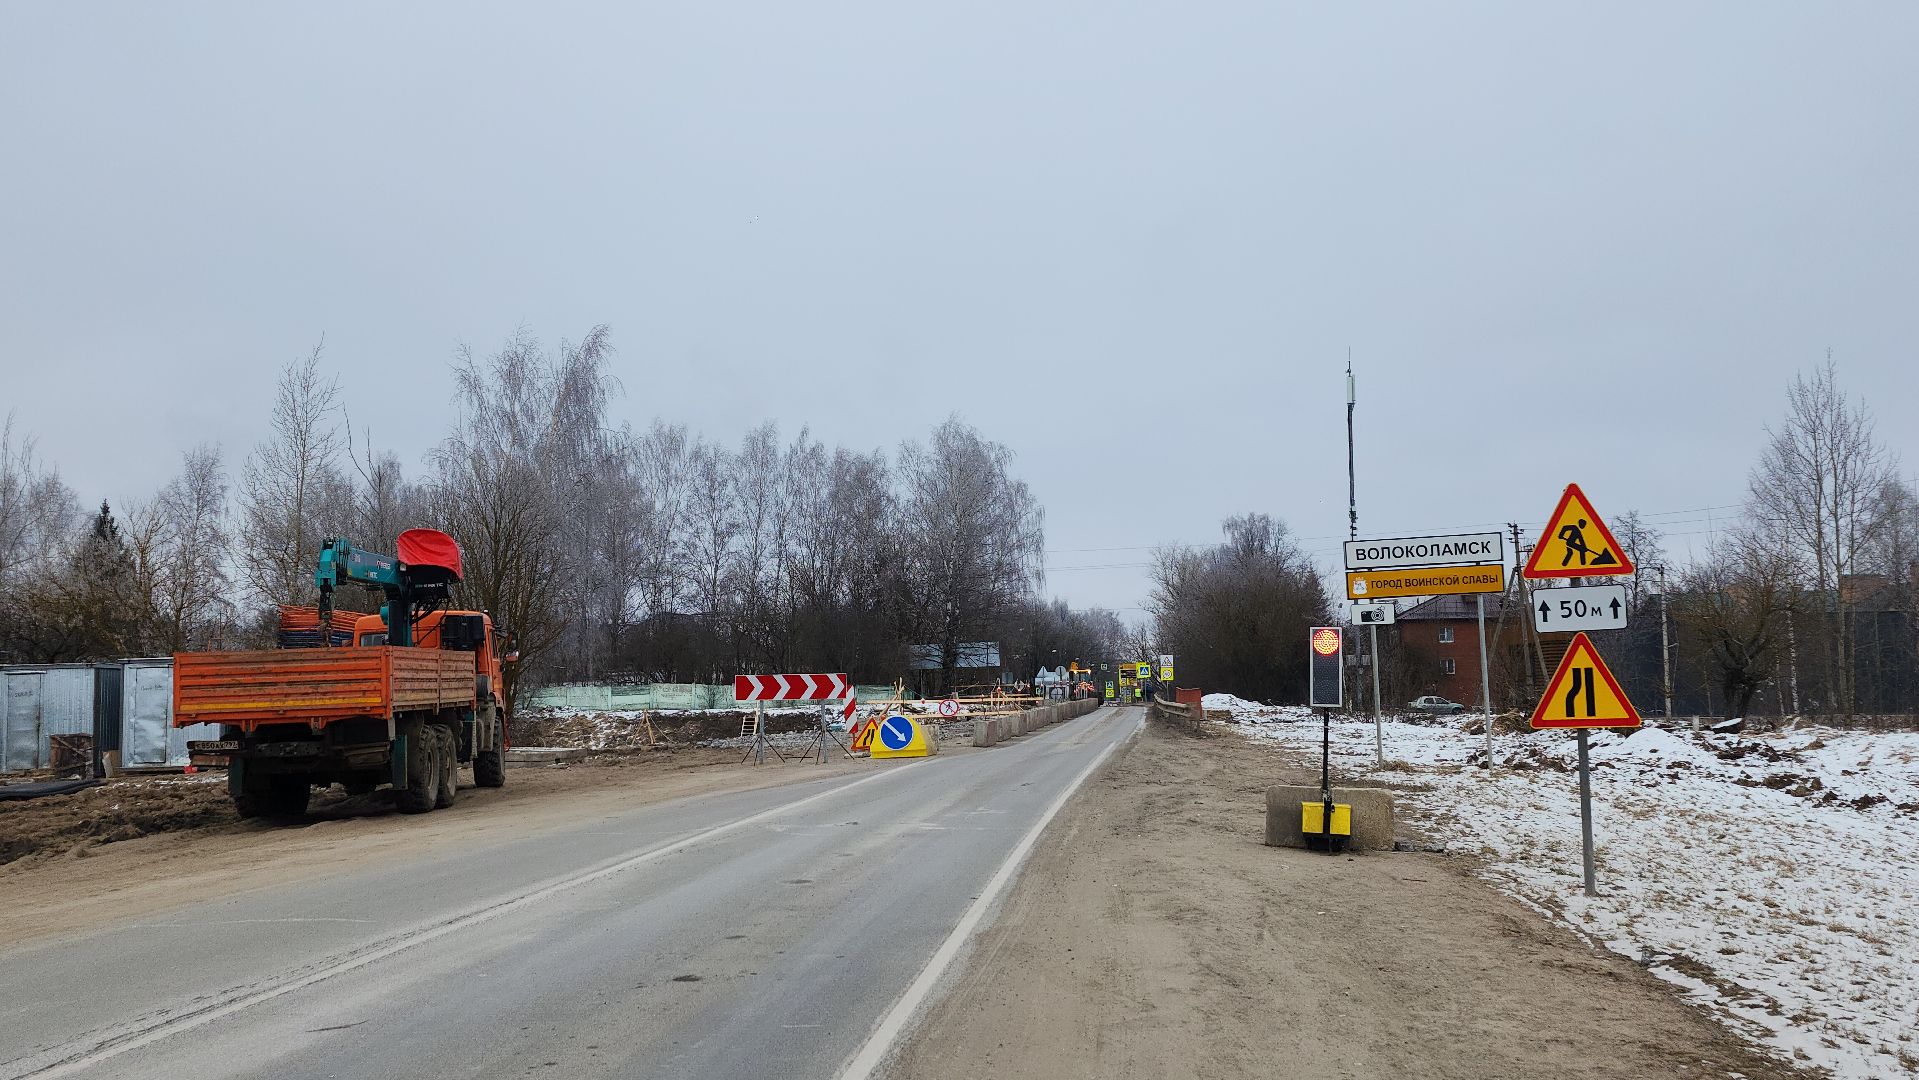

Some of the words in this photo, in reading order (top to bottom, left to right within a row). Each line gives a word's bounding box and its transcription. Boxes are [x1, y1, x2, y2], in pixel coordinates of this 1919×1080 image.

[1356, 540, 1491, 561] ВОЛОКОЛАМСК
[1371, 579, 1403, 590] ГОРОД
[1404, 574, 1460, 588] ВОИНСКОЙ
[1462, 574, 1499, 585] СЛАВЫ
[1560, 599, 1587, 619] 50
